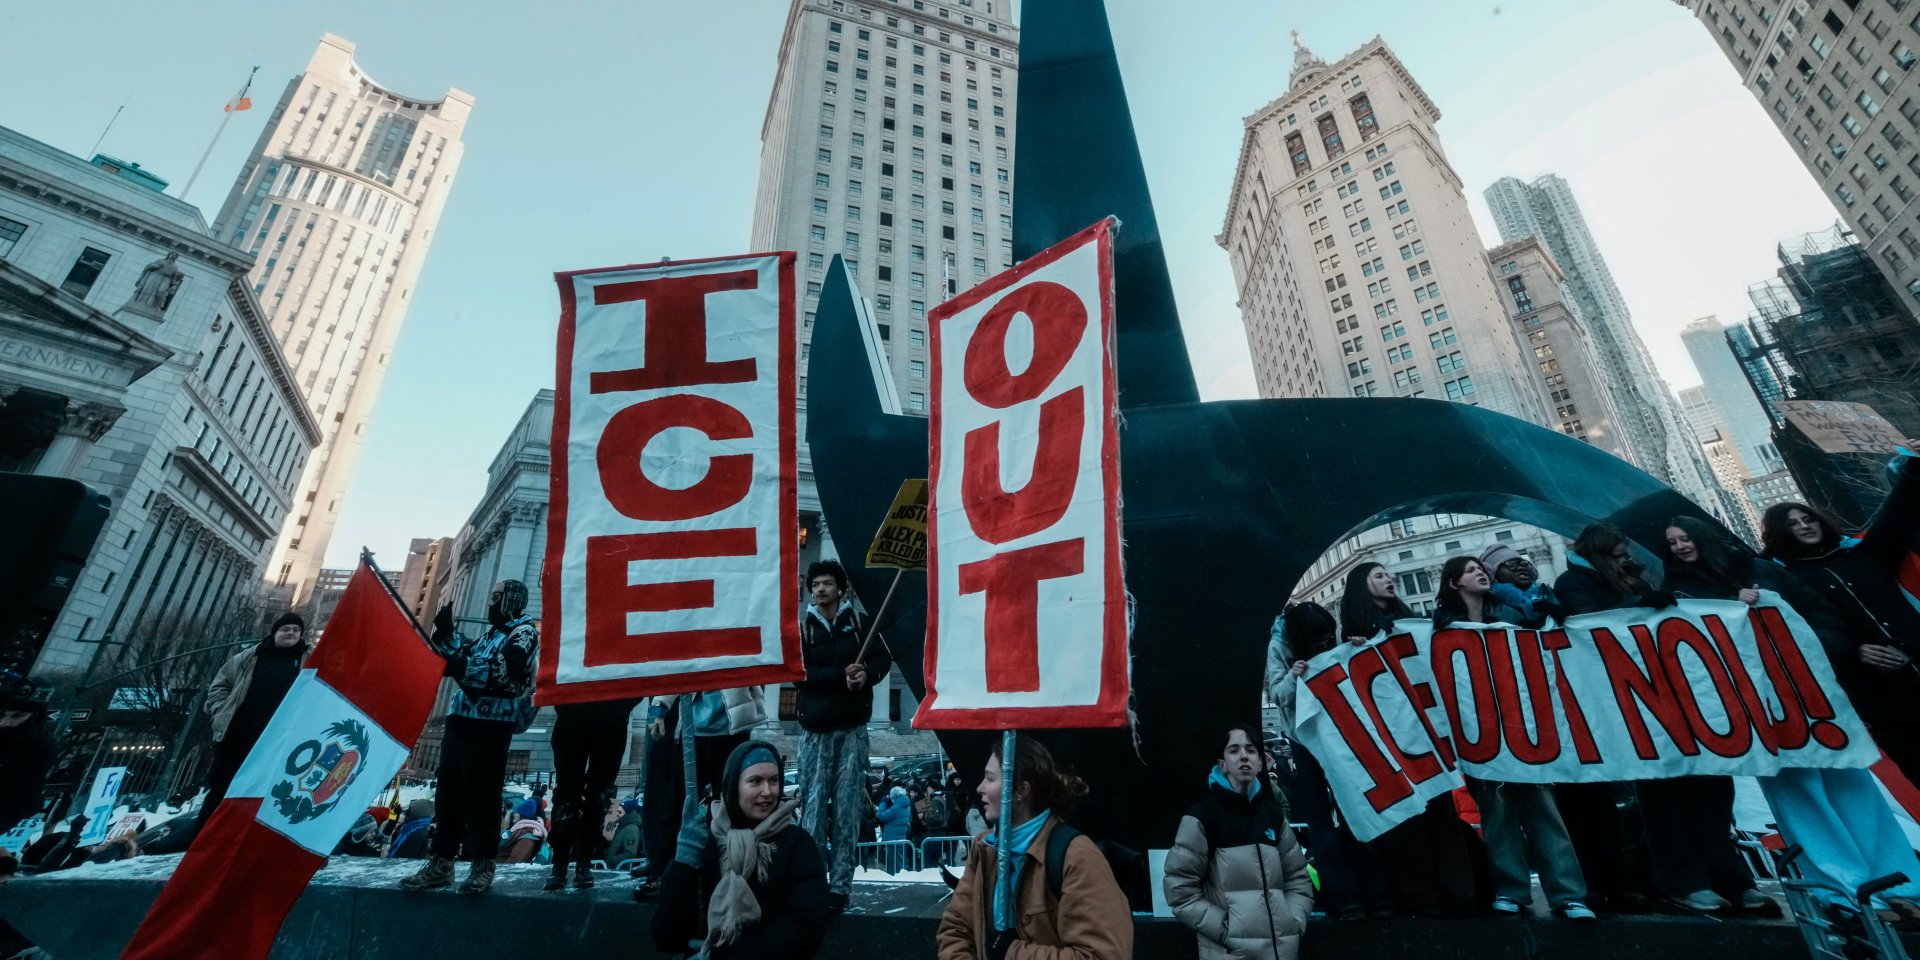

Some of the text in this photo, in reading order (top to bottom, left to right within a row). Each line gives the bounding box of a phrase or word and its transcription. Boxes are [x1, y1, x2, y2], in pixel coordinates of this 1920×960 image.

[583, 268, 762, 668] ICE
[877, 540, 914, 558] KILLED
[880, 526, 915, 545] ALEX
[957, 281, 1089, 692] OUT
[1304, 605, 1849, 815] ICE OUT NOW!
